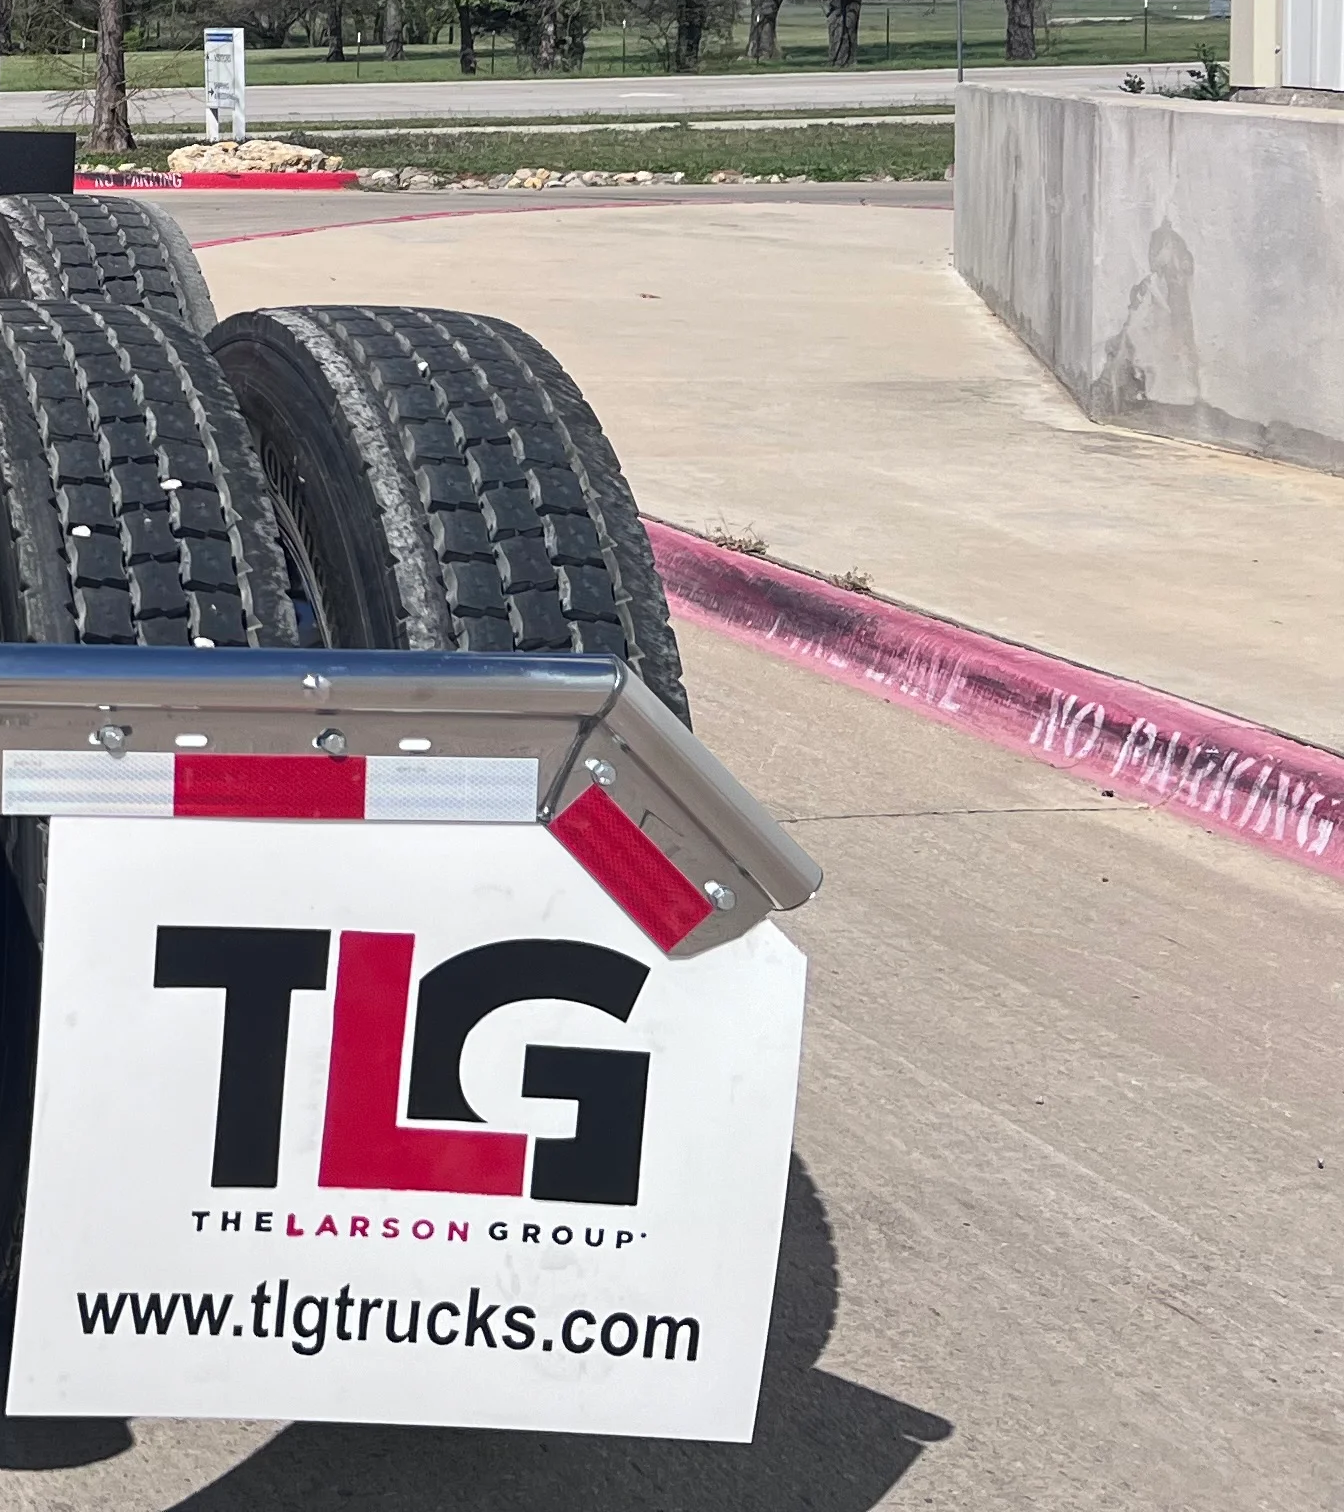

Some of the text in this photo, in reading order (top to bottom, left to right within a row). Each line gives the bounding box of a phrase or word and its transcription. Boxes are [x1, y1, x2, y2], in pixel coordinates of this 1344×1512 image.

[1028, 688, 1105, 759] NO
[153, 924, 651, 1207] TLG
[488, 1221, 634, 1249] GROUP
[76, 1278, 700, 1362] www.tlgtrucks.com
